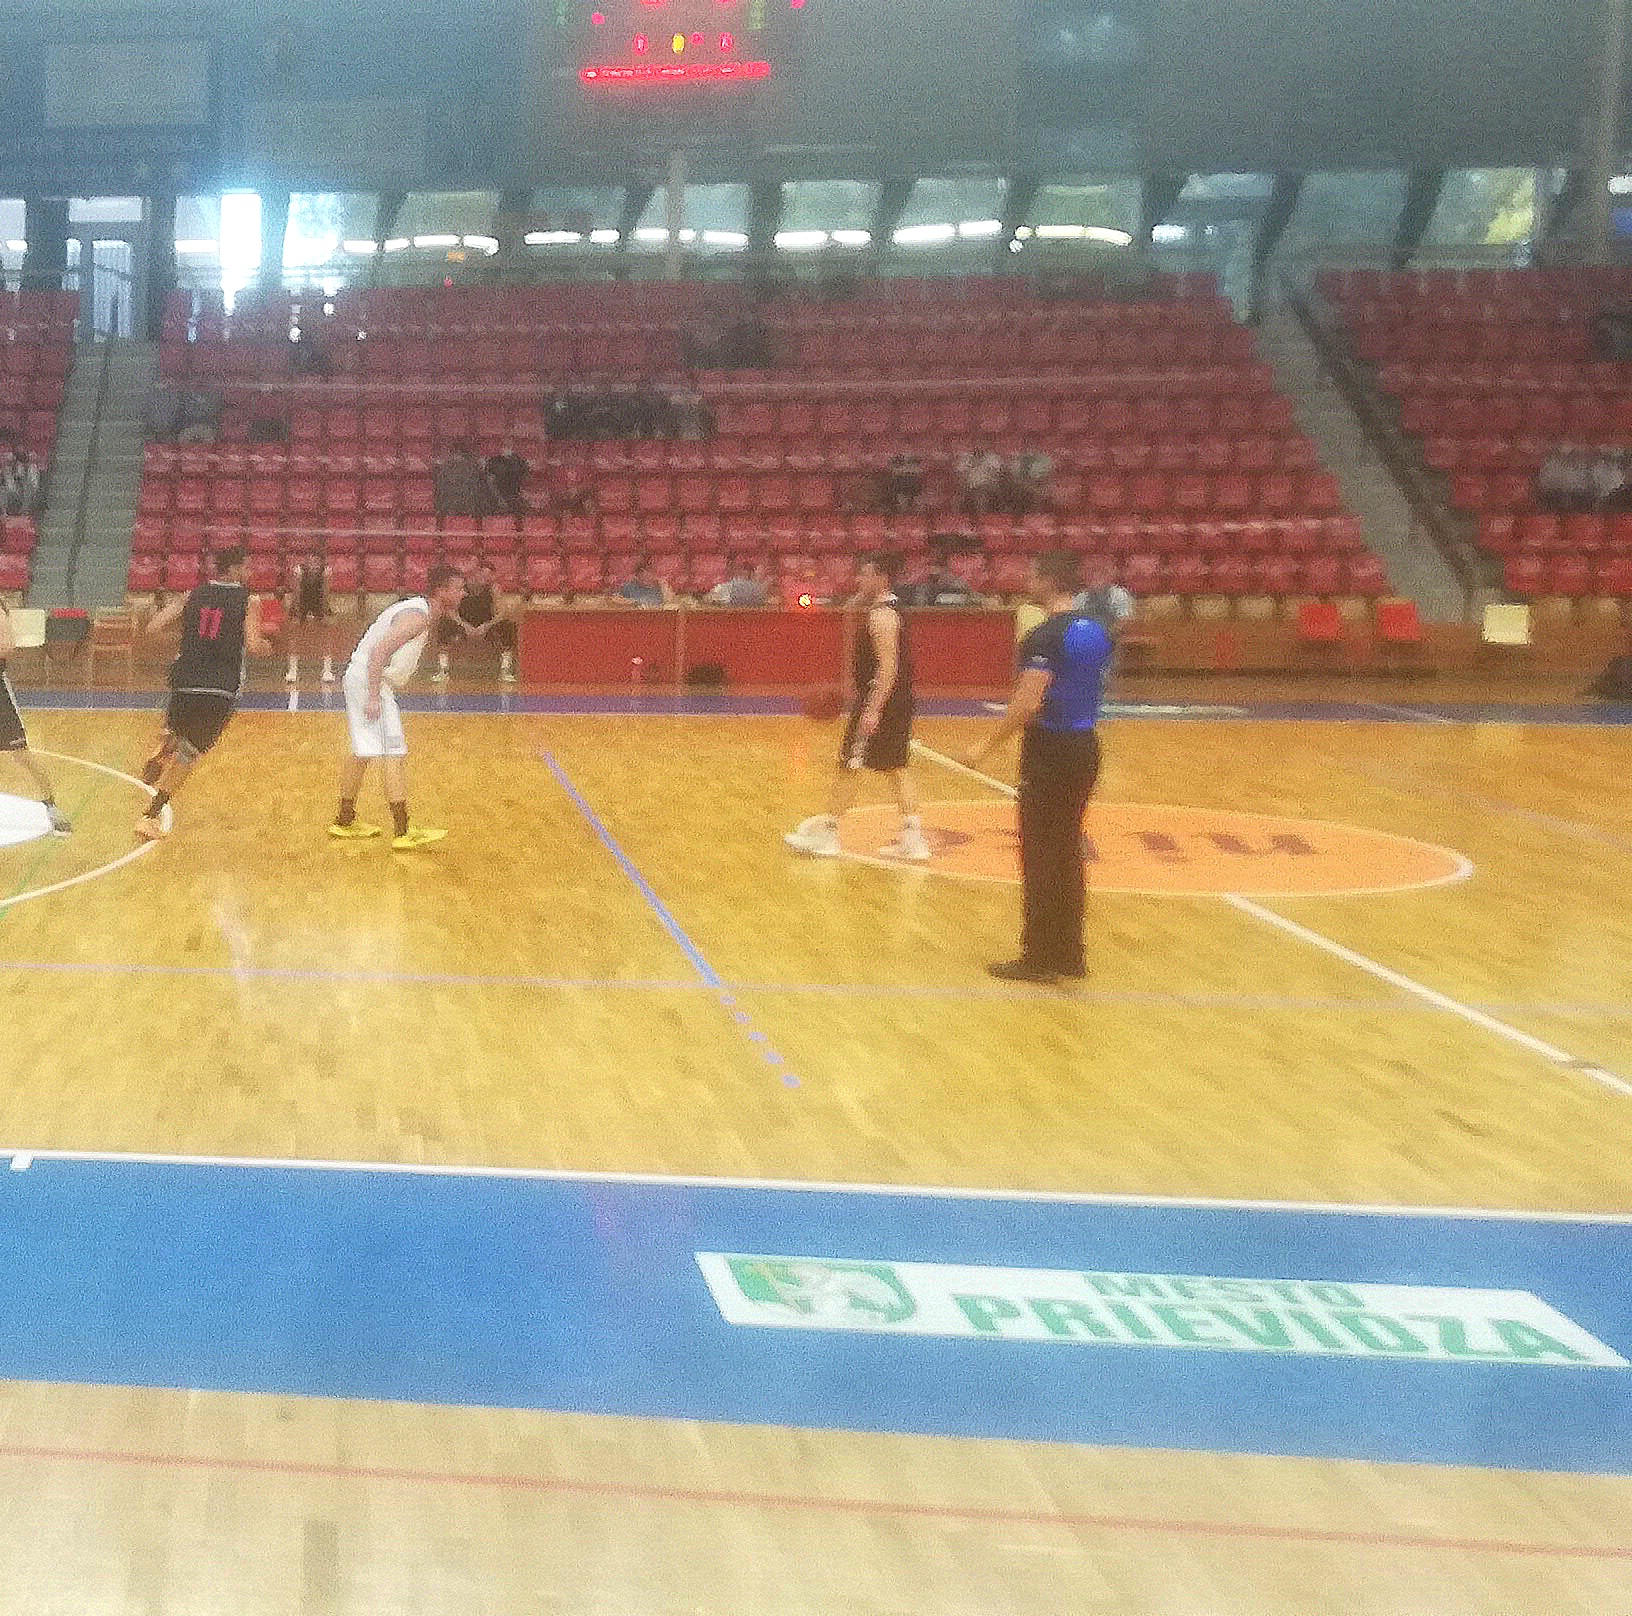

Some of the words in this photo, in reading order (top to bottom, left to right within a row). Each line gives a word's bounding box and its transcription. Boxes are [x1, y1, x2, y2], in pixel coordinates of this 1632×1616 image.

[199, 607, 225, 641] 11
[1083, 1273, 1364, 1309] MESTO
[951, 1293, 1593, 1361] PRIEVIDZA
